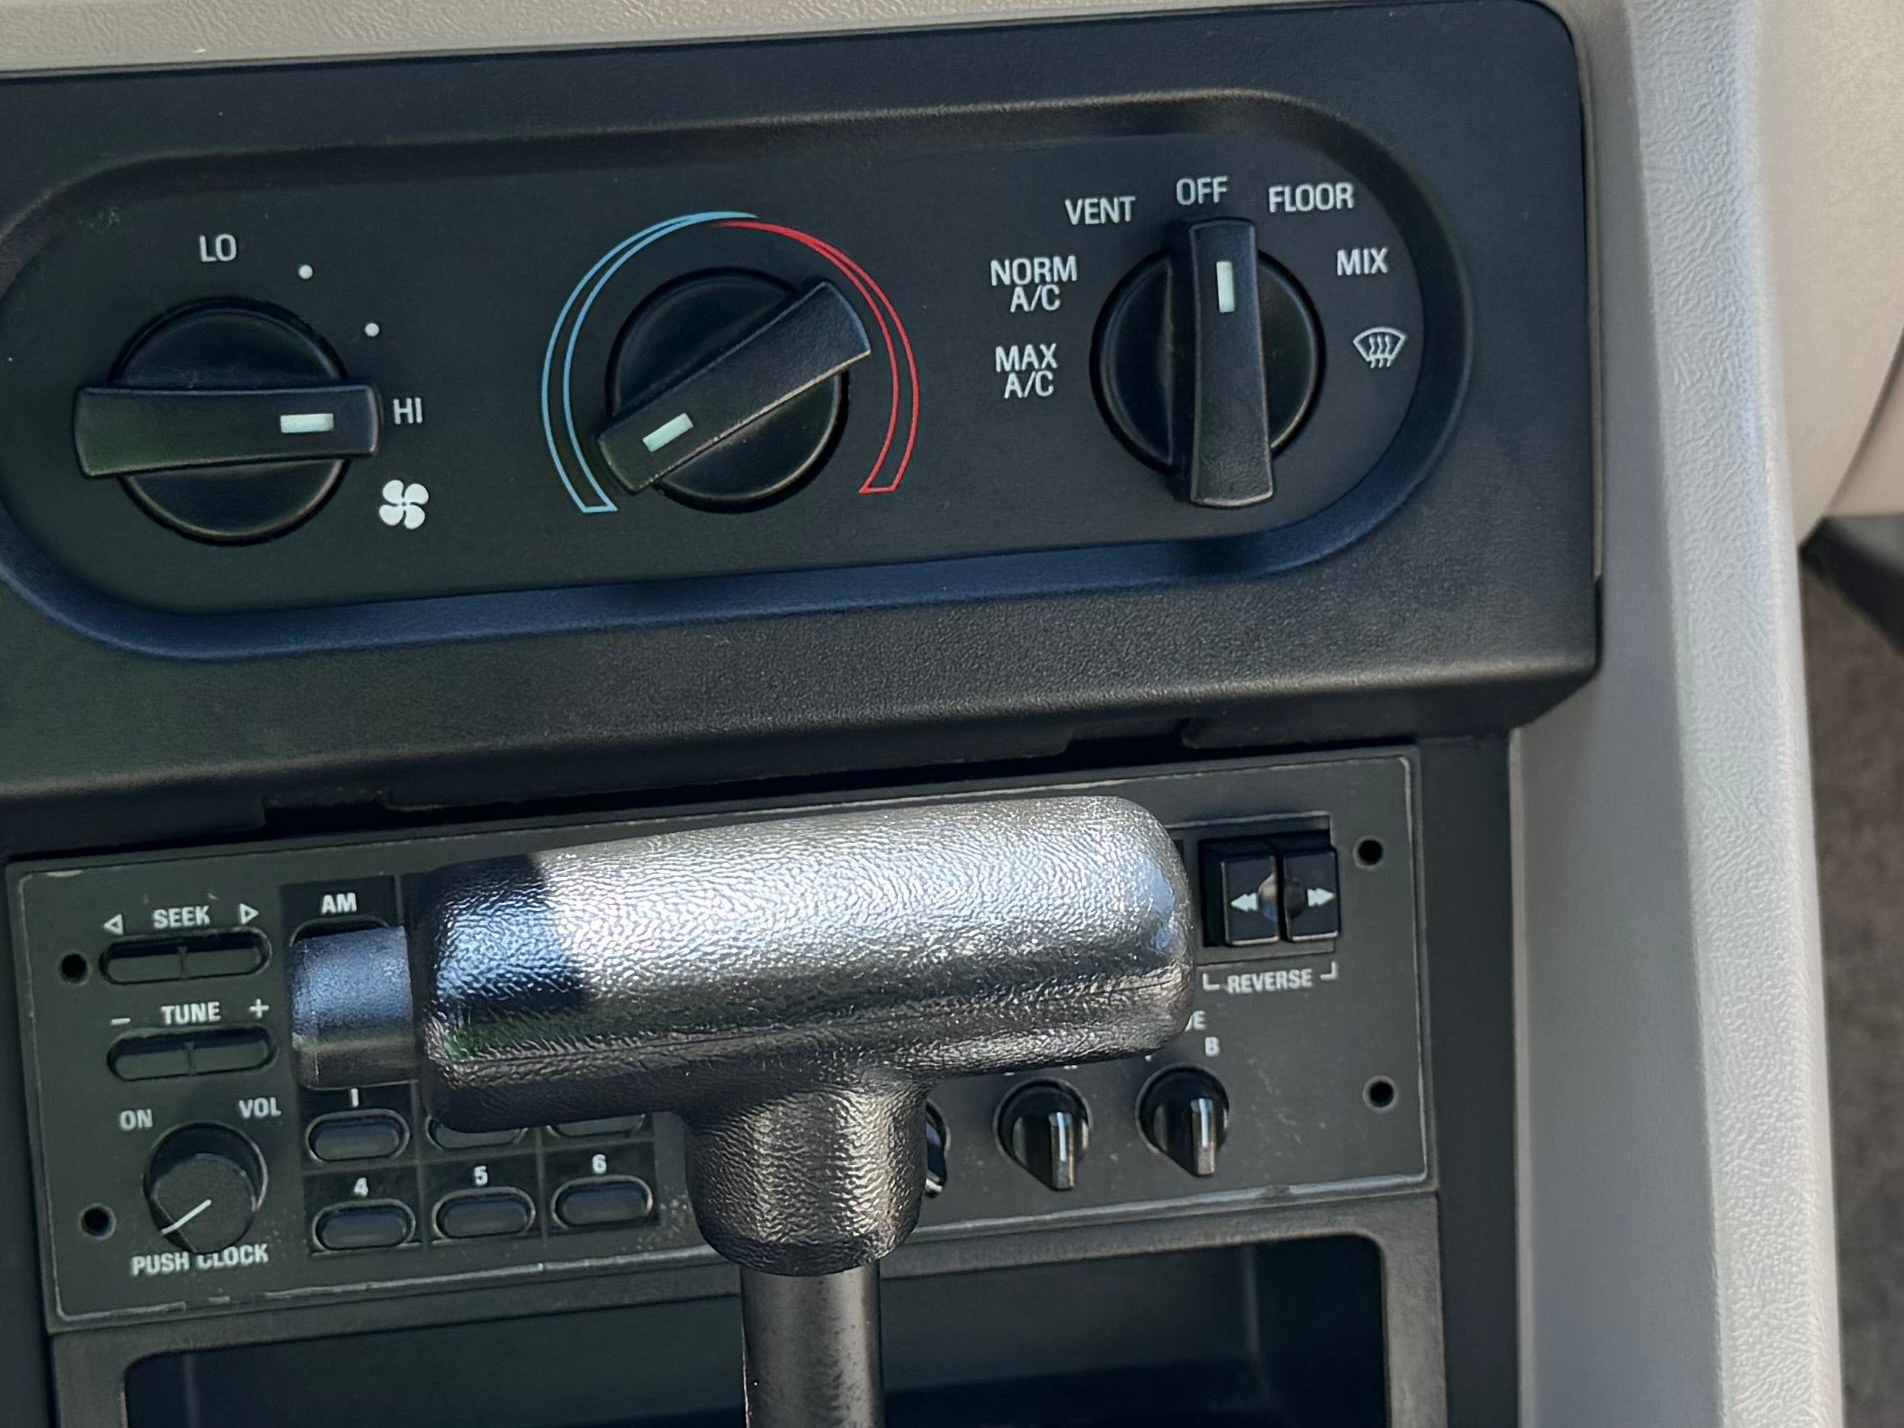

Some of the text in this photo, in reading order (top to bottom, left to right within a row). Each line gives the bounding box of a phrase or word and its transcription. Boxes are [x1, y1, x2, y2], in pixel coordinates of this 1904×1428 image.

[1177, 176, 1227, 205] OFF
[1269, 183, 1353, 212] FLOOR
[1065, 196, 1135, 225] VENT
[200, 234, 236, 261] LO
[991, 256, 1077, 286] NORM
[1337, 248, 1387, 275] MIX
[1011, 282, 1060, 312] A/C
[996, 343, 1057, 372] MAX
[1005, 368, 1053, 398] A/C
[393, 398, 422, 424] HI
[322, 893, 356, 913] AM
[153, 906, 209, 928] SEEK
[1225, 969, 1312, 993] REVERSE
[161, 1002, 220, 1024] TUNE
[1205, 1037, 1219, 1056] B
[120, 1109, 152, 1130] ON
[239, 1097, 281, 1118] VOL
[474, 1166, 488, 1185] 5
[593, 1154, 606, 1173] 6
[354, 1178, 368, 1196] 4
[132, 1244, 268, 1275] PUSH CLOCK
